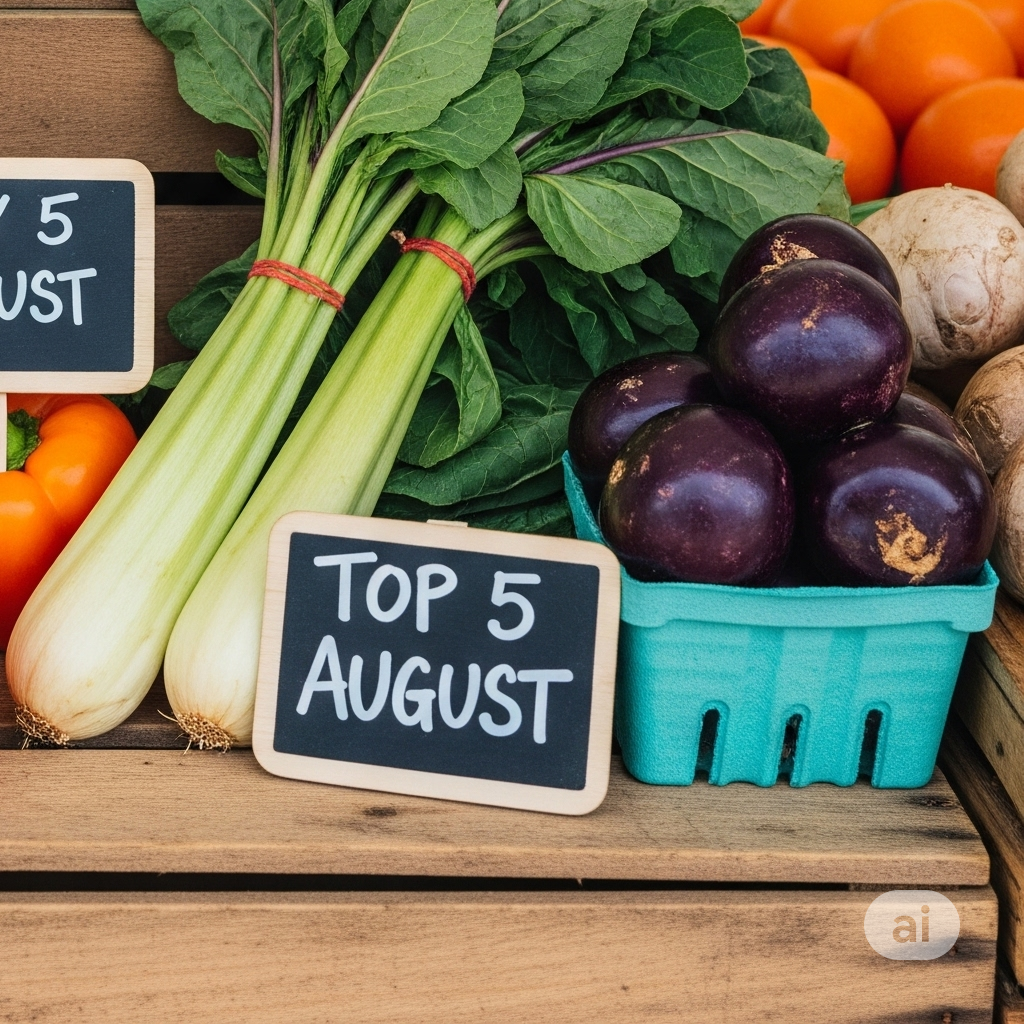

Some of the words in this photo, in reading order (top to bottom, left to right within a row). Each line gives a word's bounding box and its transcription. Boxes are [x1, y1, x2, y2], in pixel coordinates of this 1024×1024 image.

[36, 192, 80, 246] 5
[314, 552, 458, 633] TOP
[487, 571, 542, 641] 5
[296, 635, 574, 745] AUGUST
